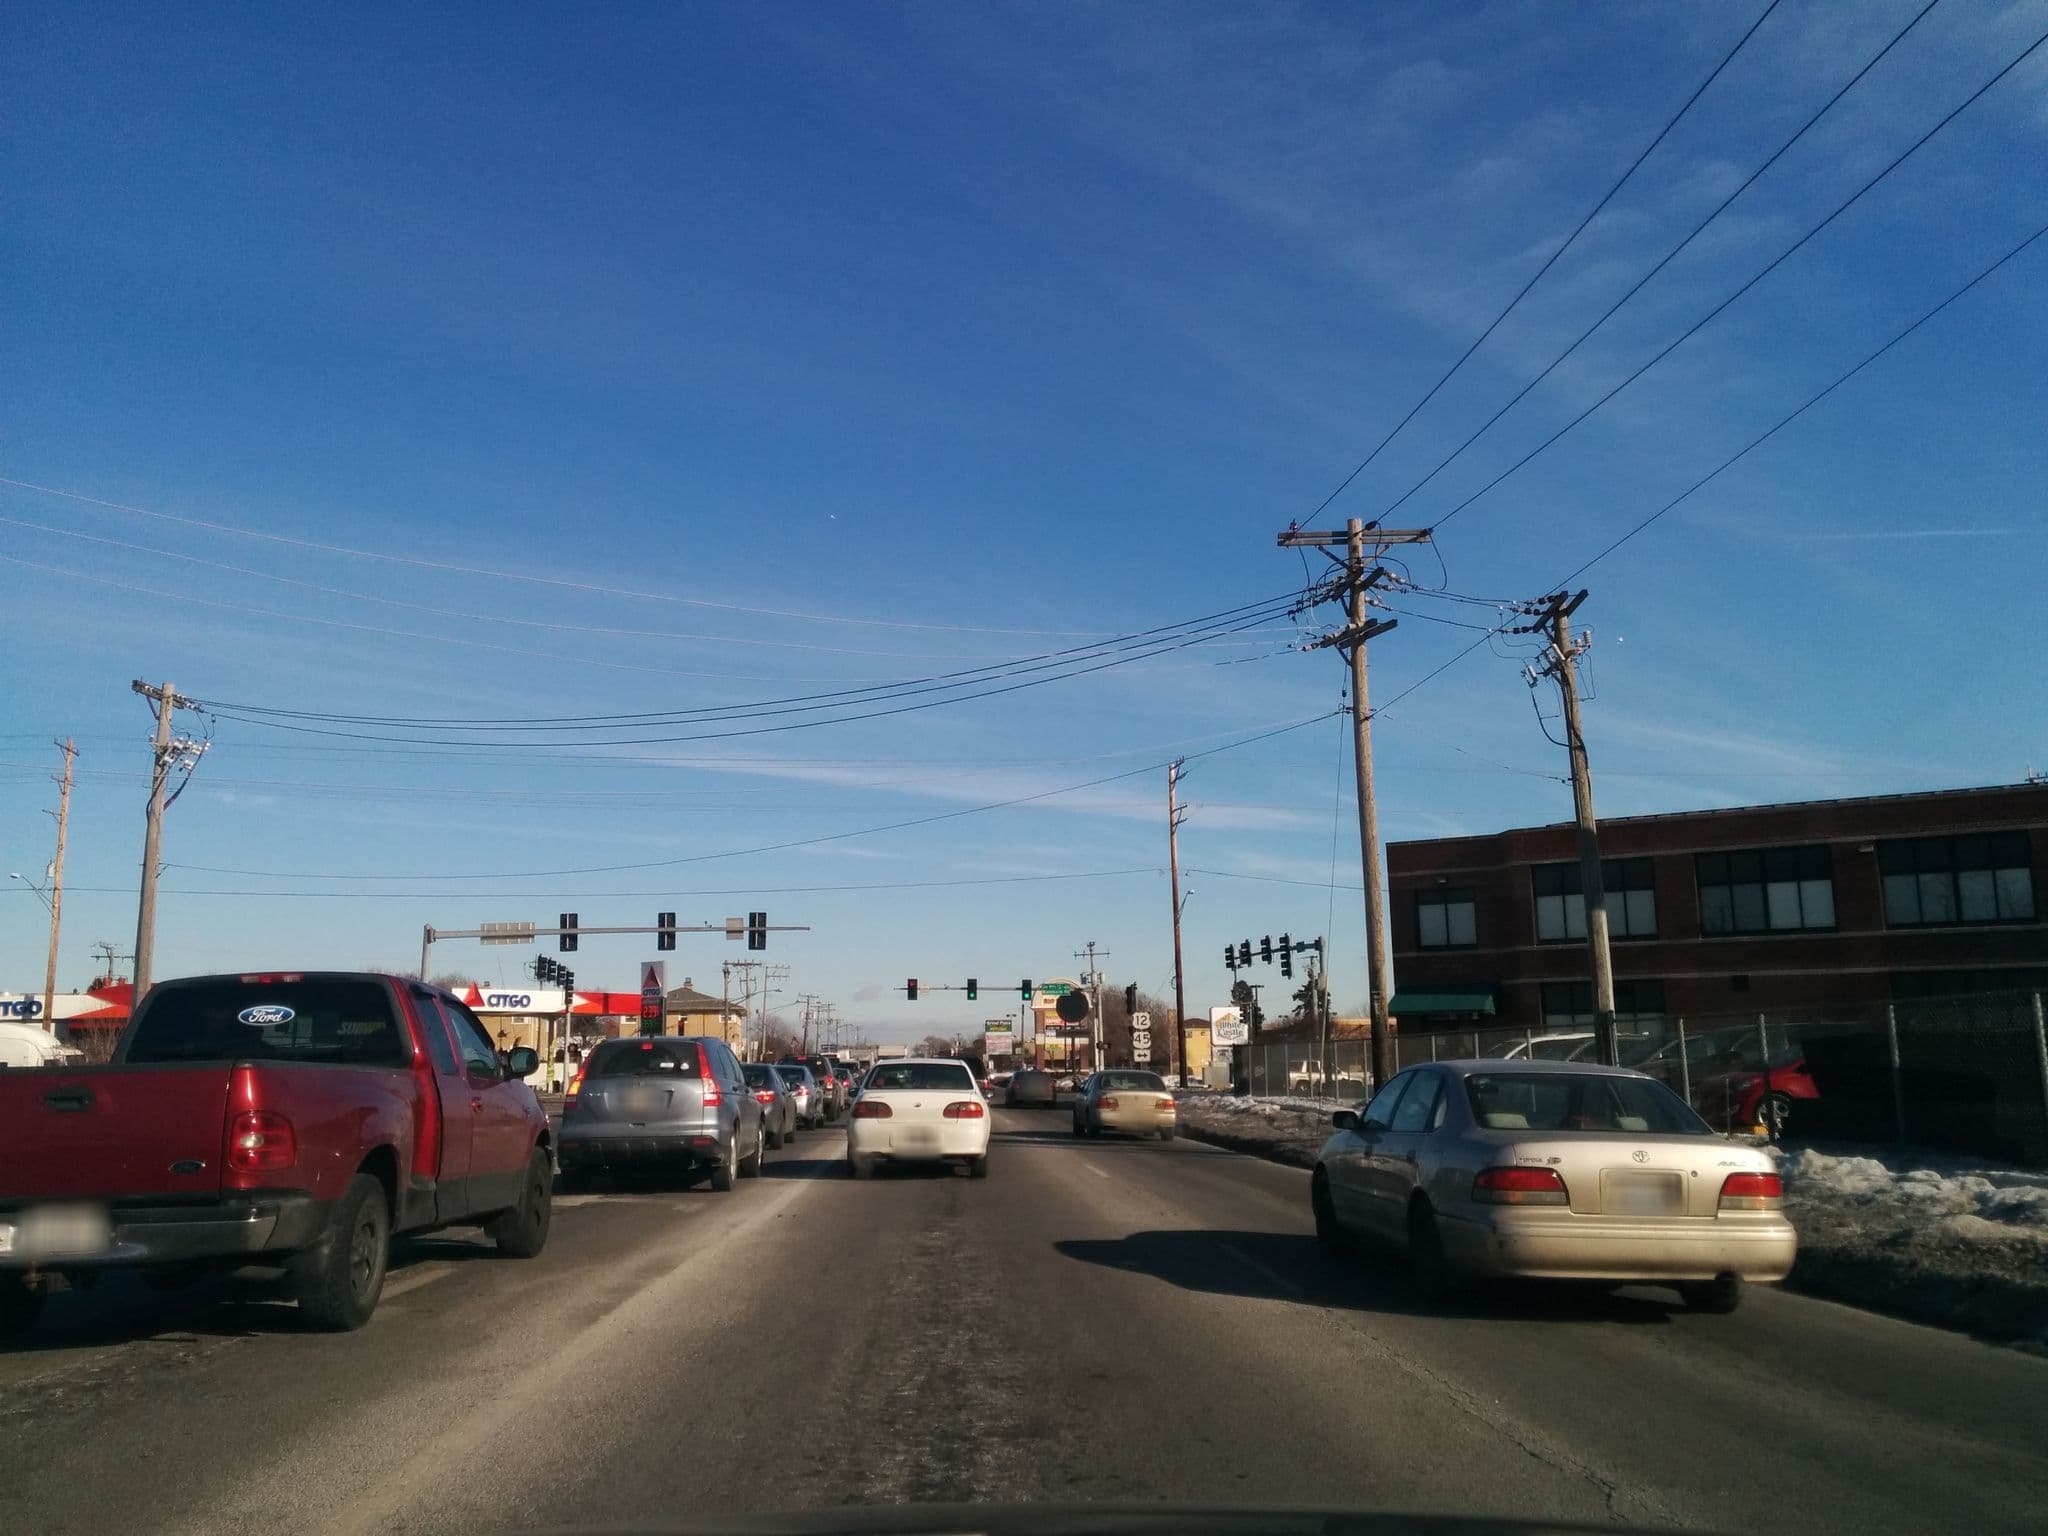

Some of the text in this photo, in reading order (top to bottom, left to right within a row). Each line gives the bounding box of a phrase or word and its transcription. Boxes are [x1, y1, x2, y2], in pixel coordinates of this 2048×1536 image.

[487, 994, 531, 1008] CITGO
[249, 1006, 283, 1023] Ford
[1135, 1015, 1148, 1026] 12
[1219, 1021, 1242, 1029] White
[1134, 1033, 1151, 1044] 45
[1216, 1029, 1244, 1037] Castle
